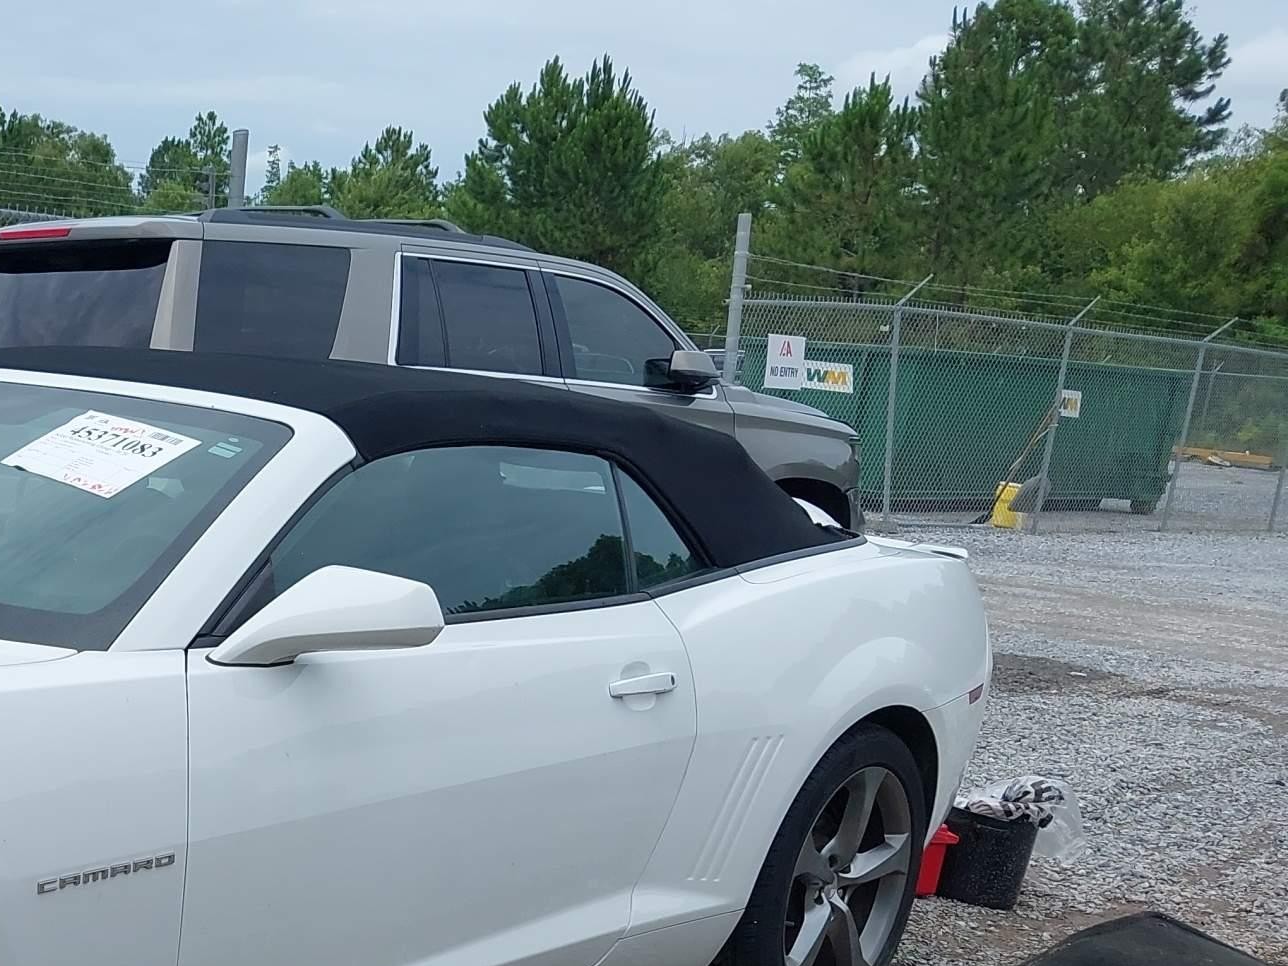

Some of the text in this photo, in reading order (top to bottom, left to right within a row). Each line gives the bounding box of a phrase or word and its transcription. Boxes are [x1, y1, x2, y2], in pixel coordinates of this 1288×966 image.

[769, 366, 799, 378] NO ENTRY
[806, 368, 849, 386] WM
[70, 425, 163, 458] 45371083
[37, 852, 175, 895] CAMARO
